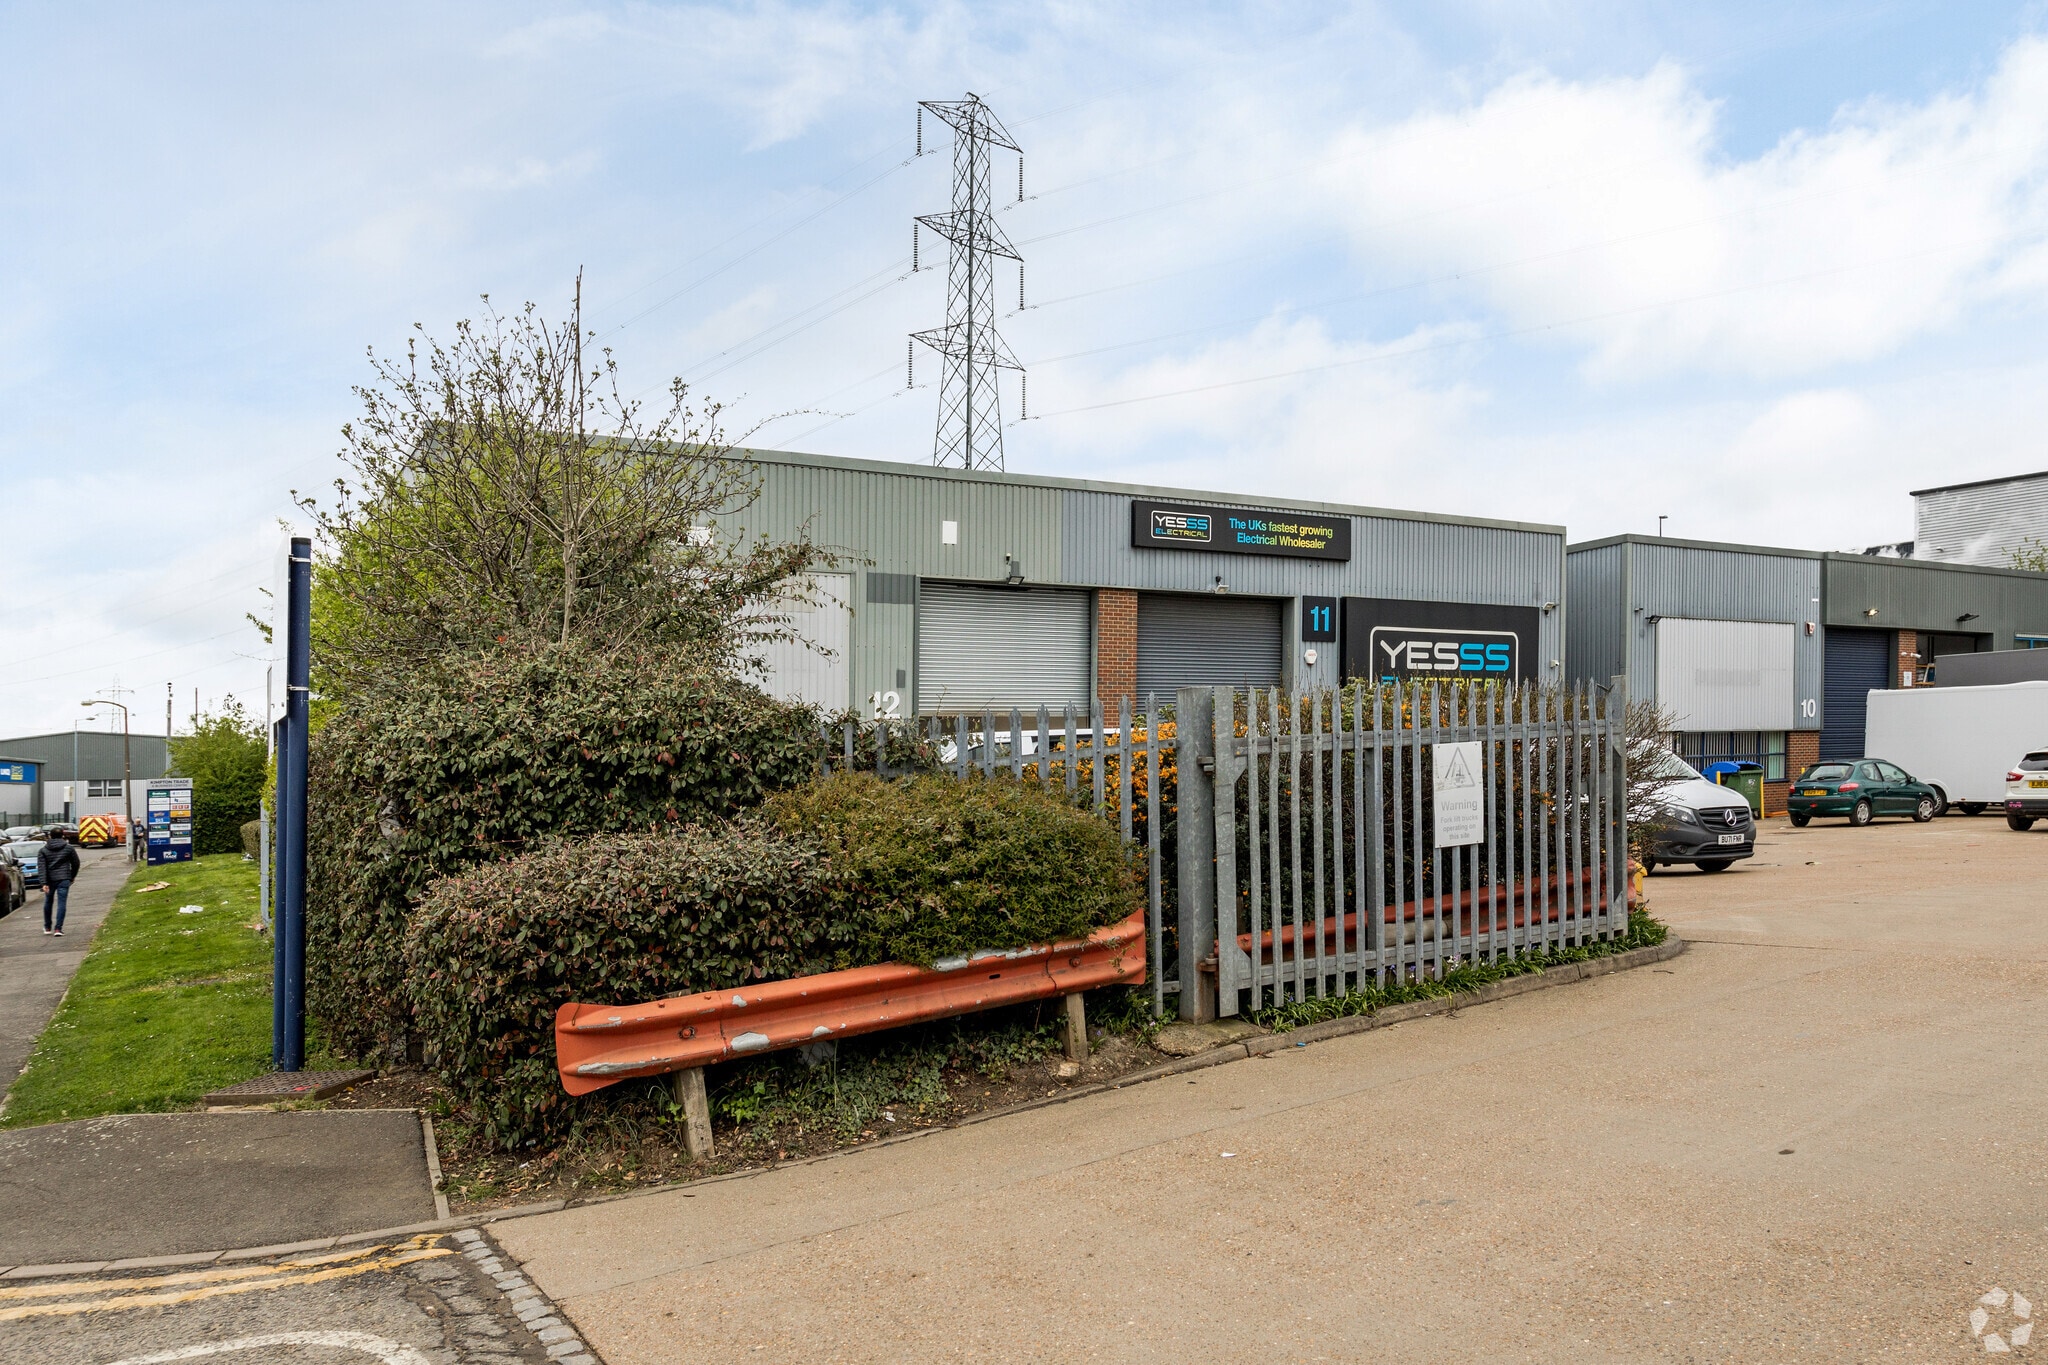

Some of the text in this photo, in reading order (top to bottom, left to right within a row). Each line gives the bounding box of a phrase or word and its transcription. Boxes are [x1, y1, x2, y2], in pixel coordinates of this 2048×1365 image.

[1155, 515, 1208, 530] YESSS
[1229, 517, 1333, 539] The UKs fastest growing
[1155, 527, 1208, 538] ELECTRICAL
[1237, 532, 1326, 549] Electrical Wholesaler
[1310, 605, 1330, 632] 11
[1380, 639, 1510, 671] YESSS
[874, 691, 901, 719] 12
[1801, 698, 1816, 718] 10
[1441, 799, 1478, 811] Warning
[1440, 816, 1453, 824] Fork
[1453, 815, 1461, 823] lift
[1442, 823, 1468, 833] operating
[1449, 832, 1459, 840] this
